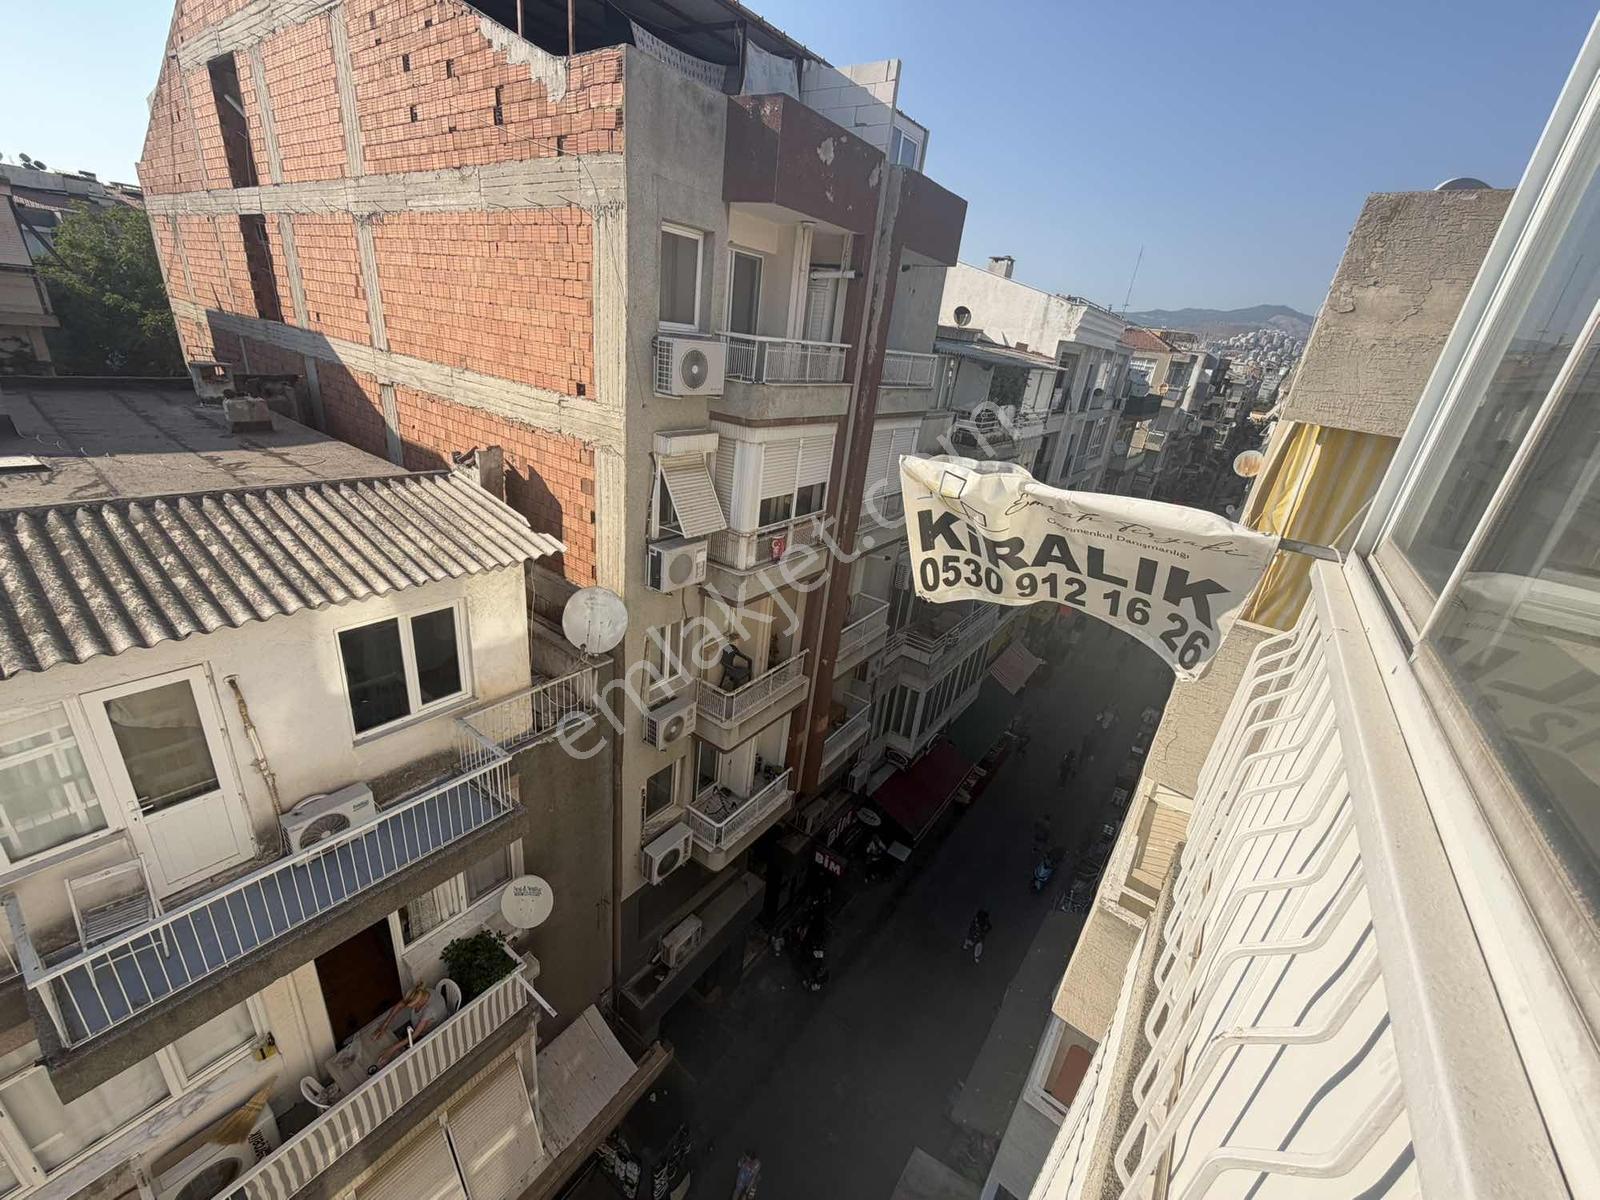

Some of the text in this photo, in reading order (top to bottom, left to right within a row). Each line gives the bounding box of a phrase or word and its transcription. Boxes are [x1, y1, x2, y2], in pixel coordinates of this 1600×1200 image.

[920, 555, 1210, 671] 0530 912 16 26
